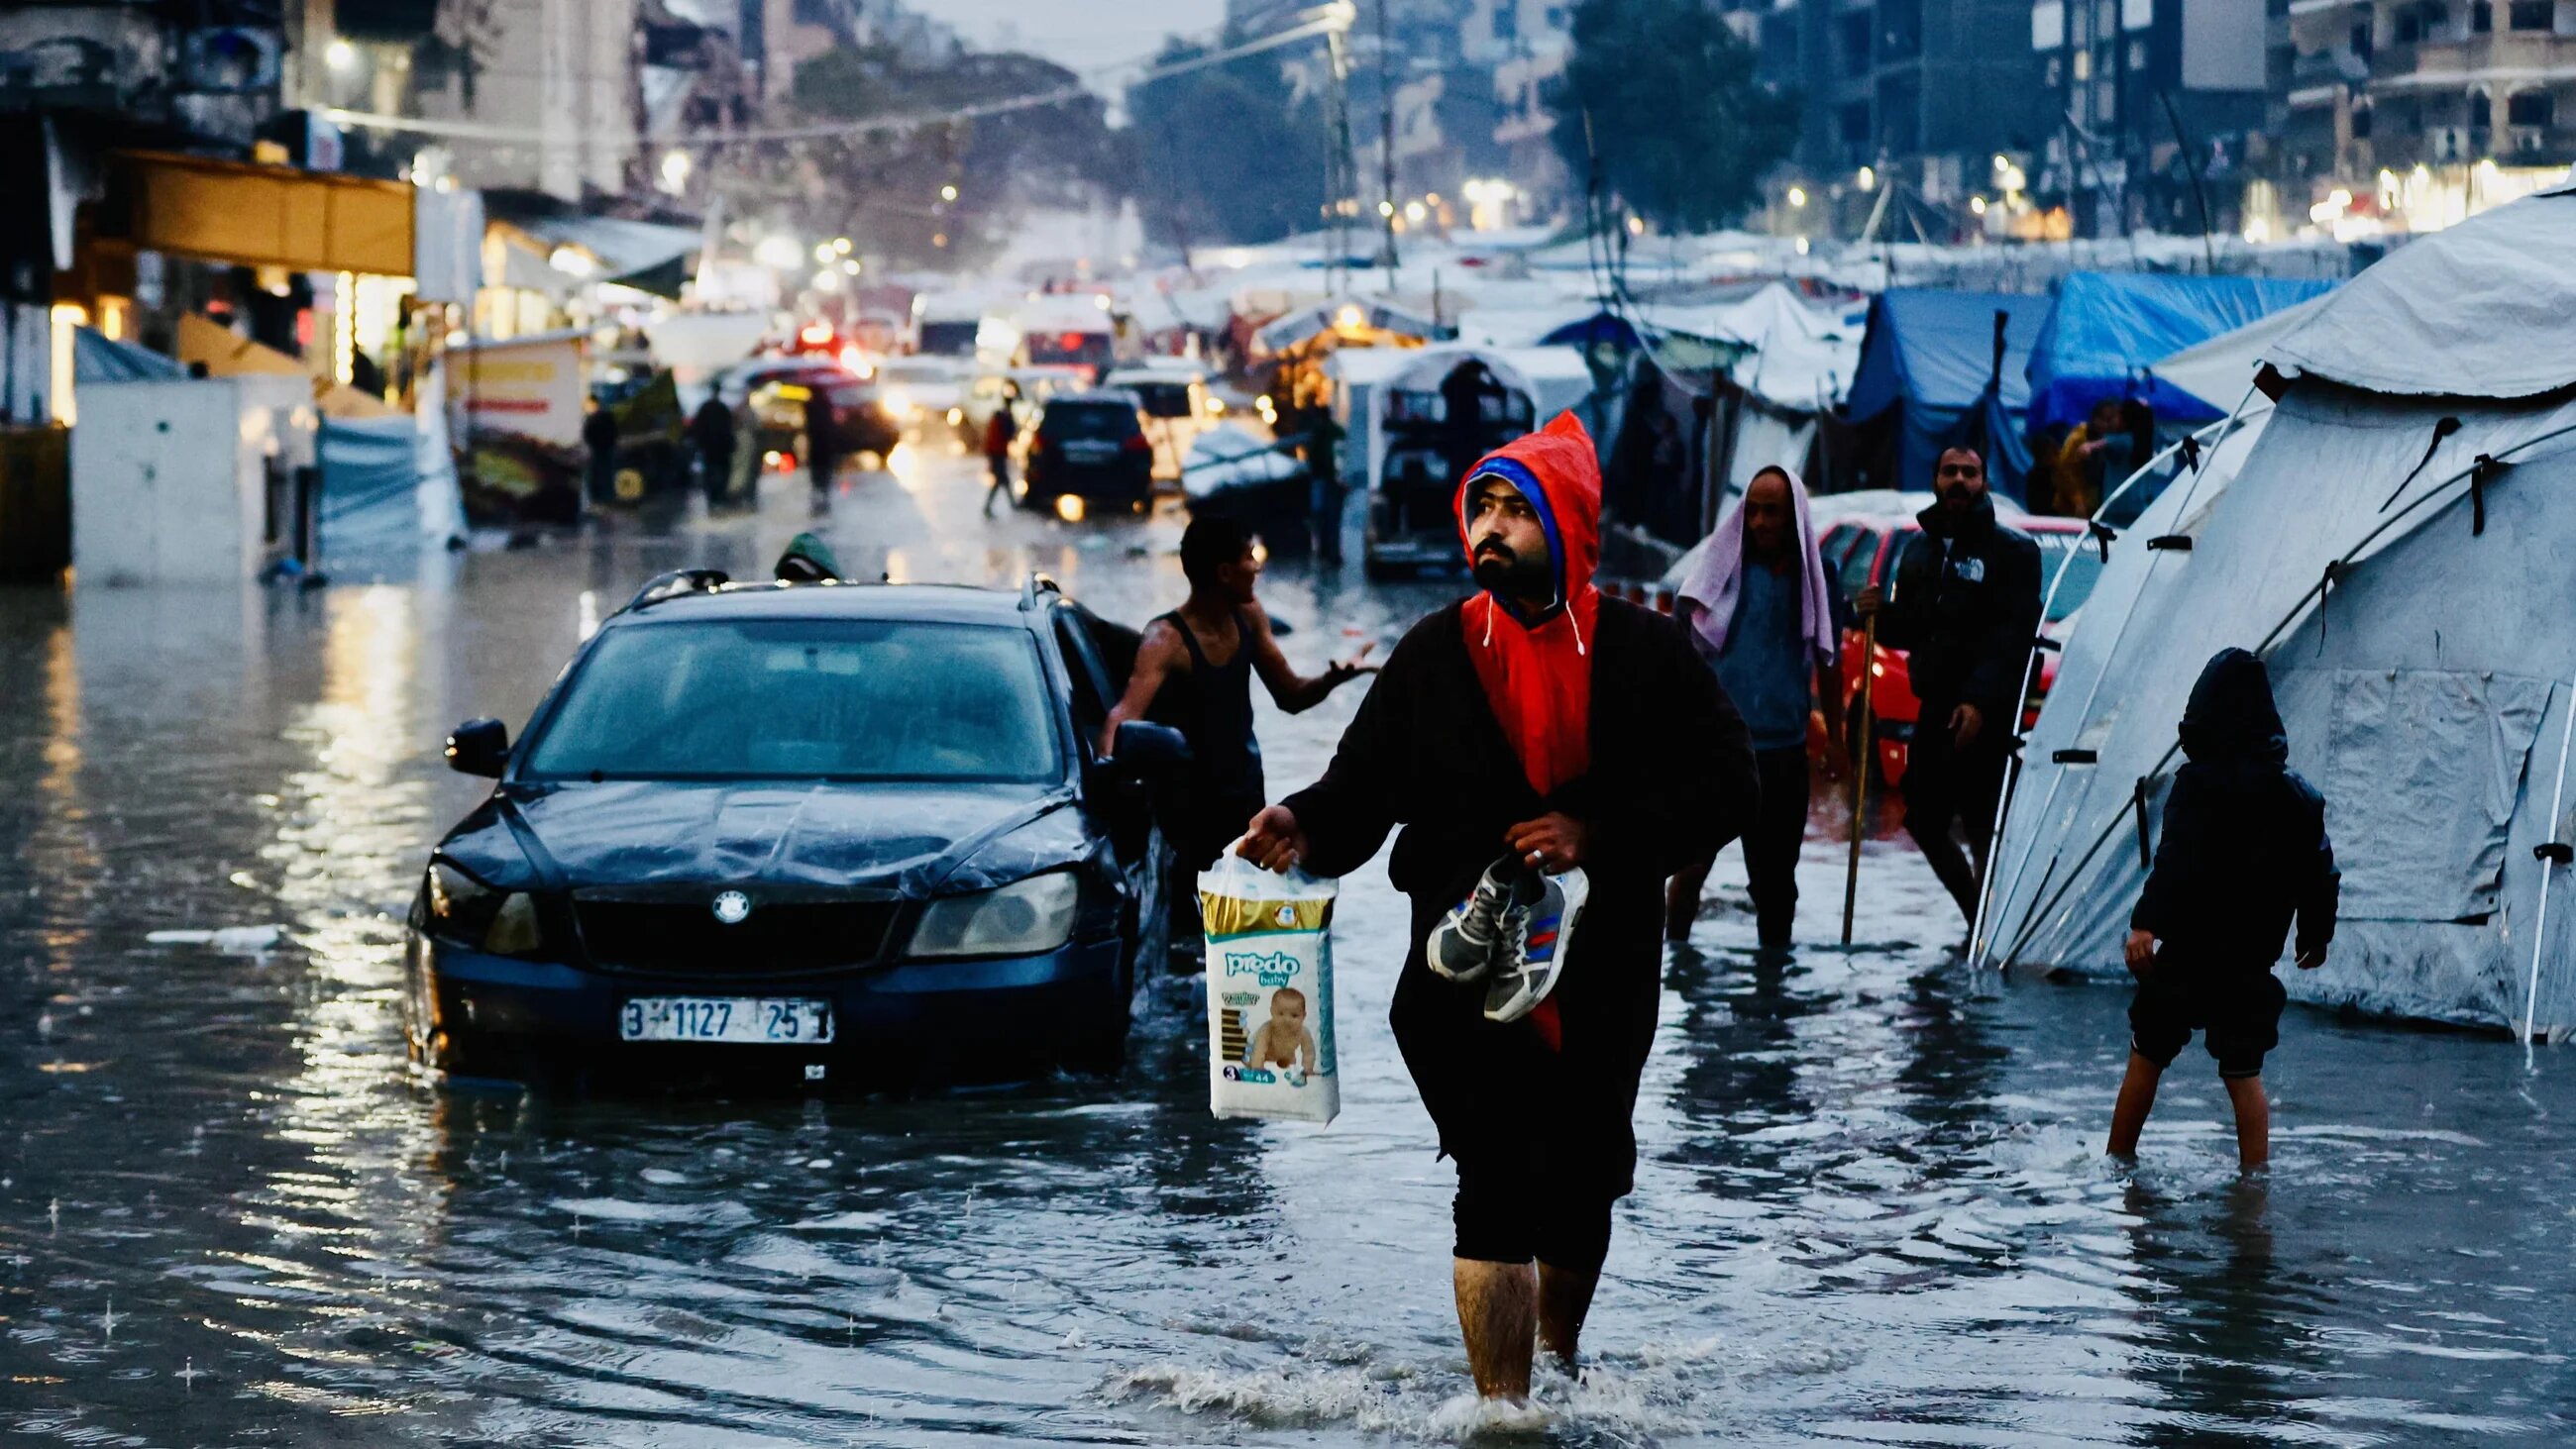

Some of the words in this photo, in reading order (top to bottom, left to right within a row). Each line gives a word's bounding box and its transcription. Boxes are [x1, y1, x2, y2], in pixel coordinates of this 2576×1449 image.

[1226, 951, 1300, 977] predo
[1260, 974, 1286, 985] baby
[1227, 1066, 1235, 1081] 3
